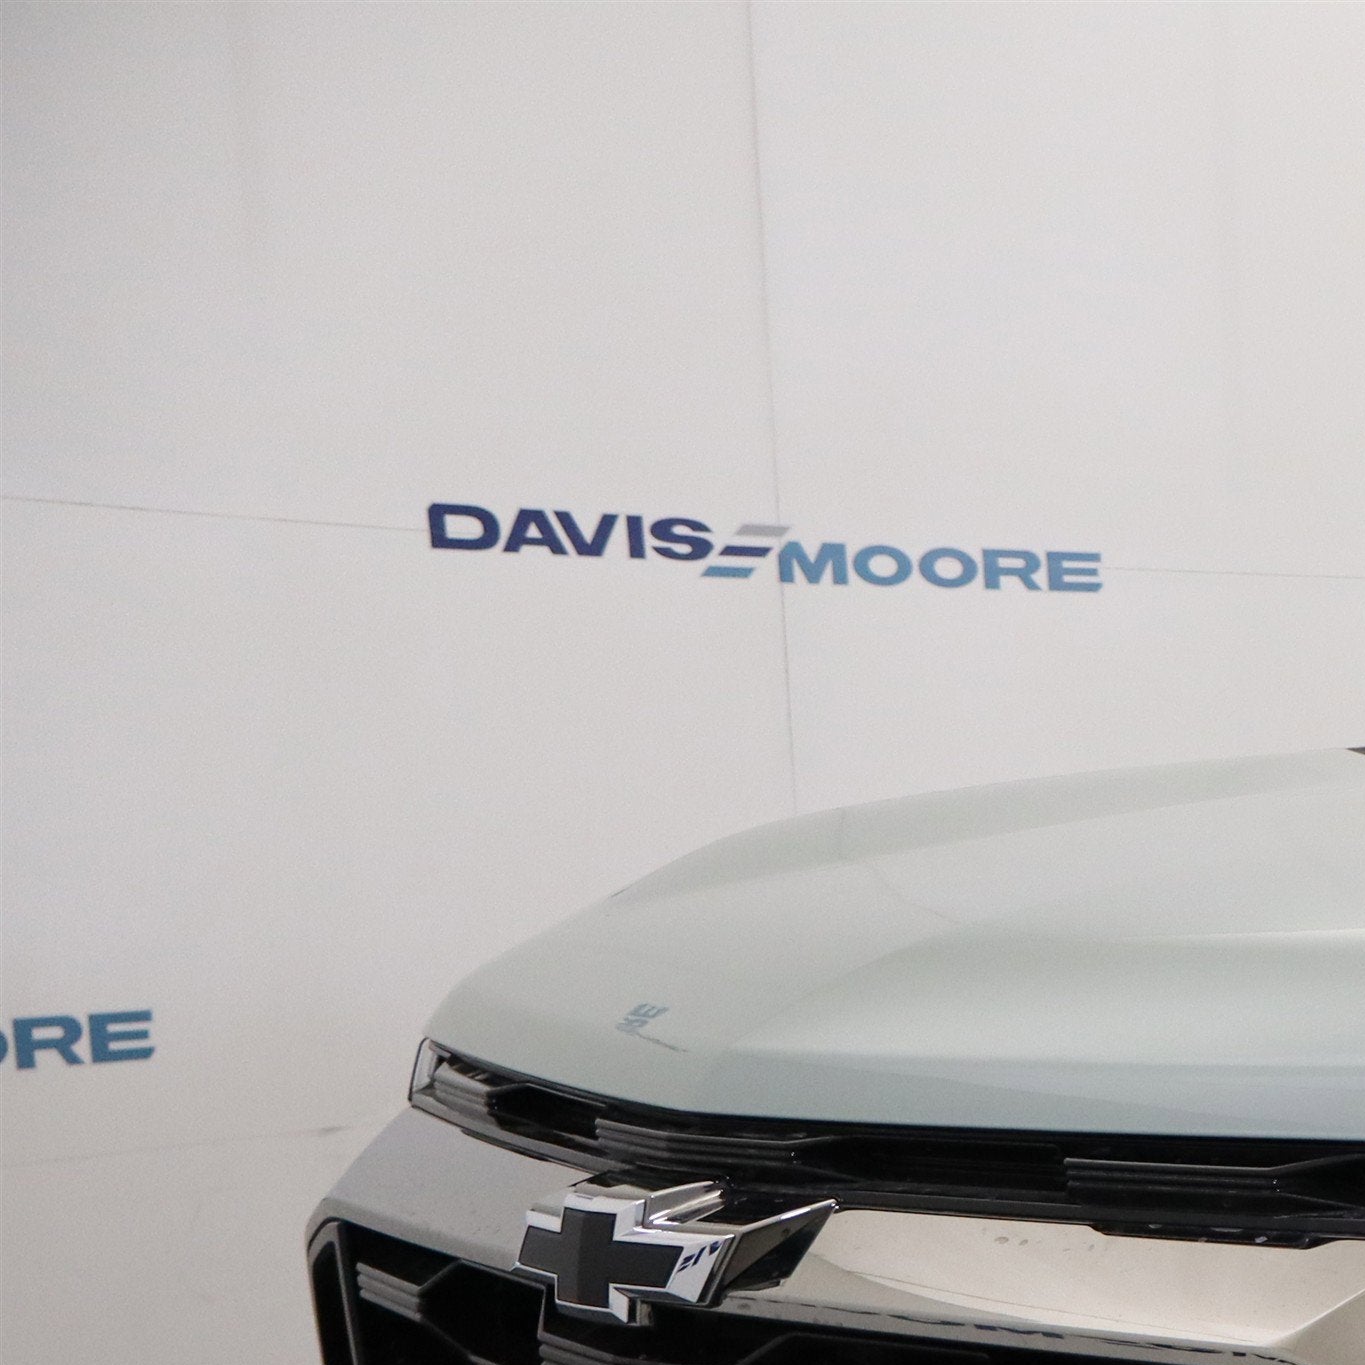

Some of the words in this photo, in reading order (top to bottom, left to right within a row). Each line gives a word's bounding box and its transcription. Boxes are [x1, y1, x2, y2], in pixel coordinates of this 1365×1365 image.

[428, 502, 713, 562] DAVIS
[778, 540, 1102, 592] MOORE
[0, 1009, 155, 1070] RE
